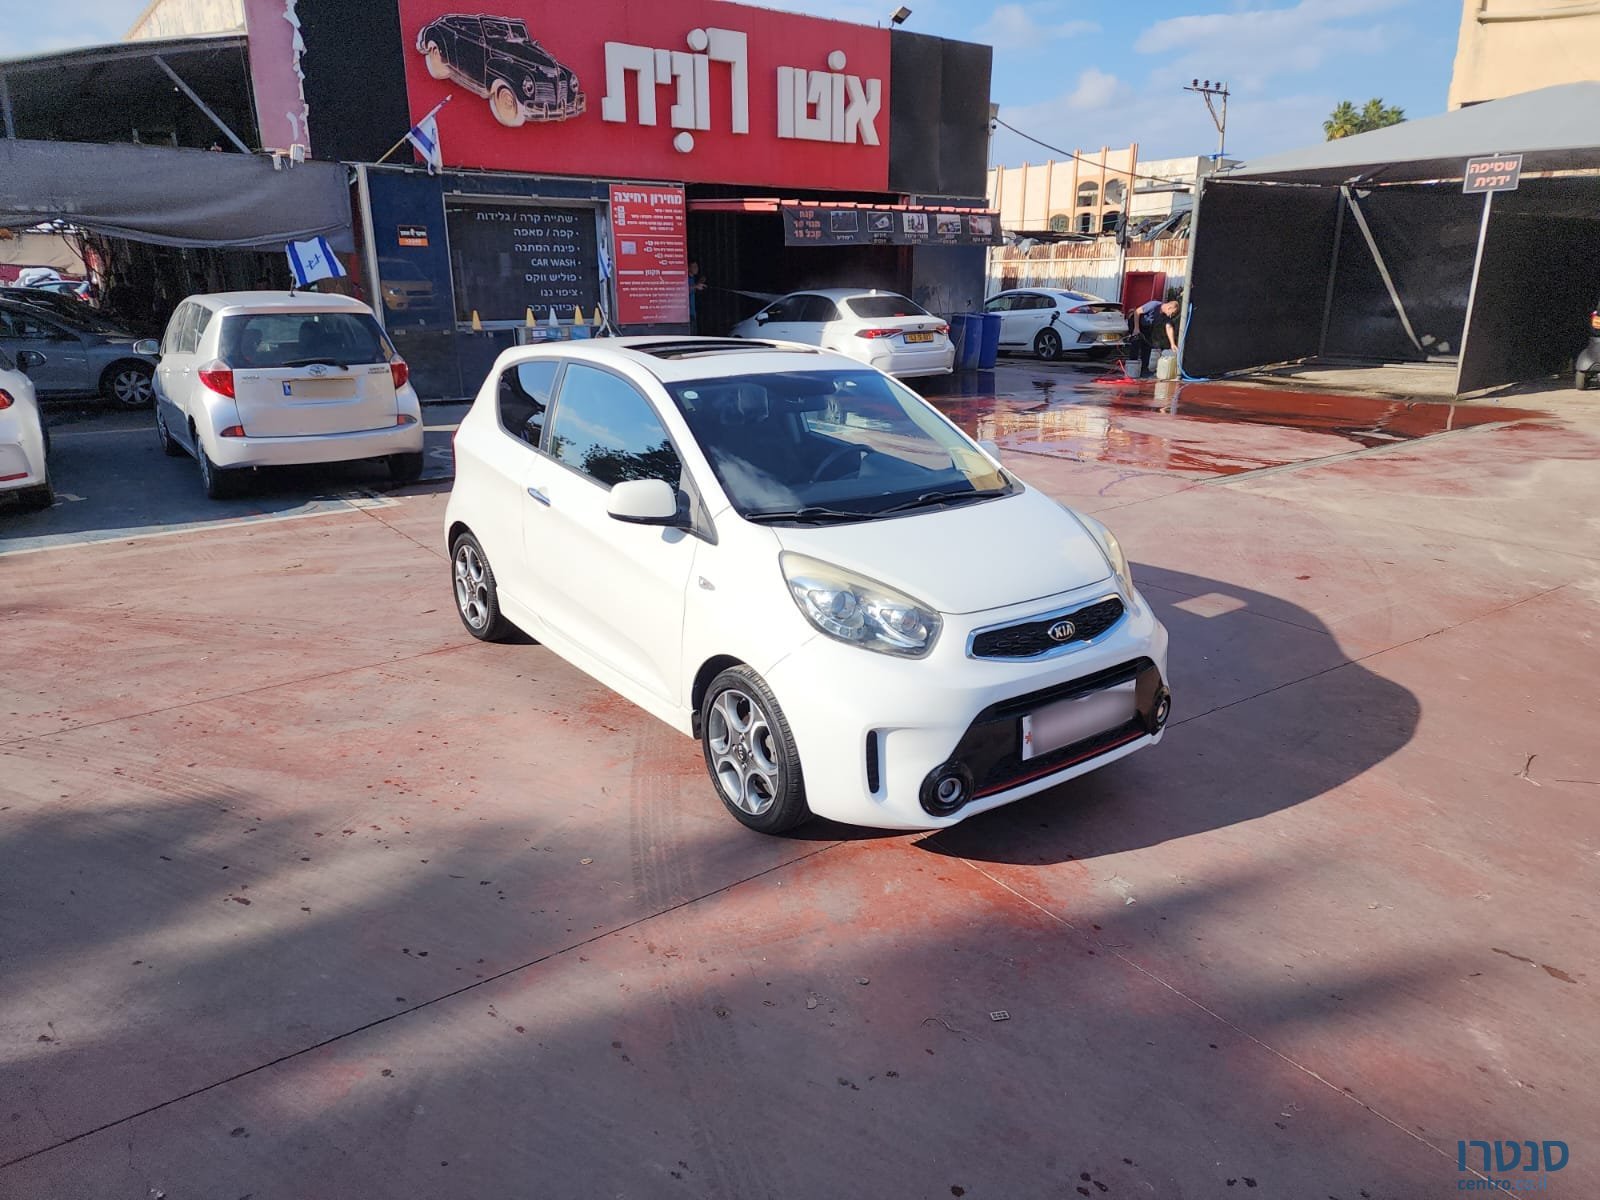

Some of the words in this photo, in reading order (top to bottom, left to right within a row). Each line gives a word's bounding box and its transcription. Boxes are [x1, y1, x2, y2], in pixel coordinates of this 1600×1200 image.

[777, 50, 882, 146] אוטו
[1473, 175, 1511, 187] ידנית
[614, 191, 648, 204] רחיצה
[650, 193, 683, 206] מחירון
[476, 211, 511, 221] גלידות
[519, 213, 541, 224] קרה
[543, 214, 573, 223] שתייה
[513, 227, 544, 236] מאפה
[552, 229, 574, 239] קפה
[552, 244, 575, 253] פינת
[531, 258, 549, 267] CAR
[550, 258, 577, 268] WASH
[525, 273, 547, 284] ווקס
[549, 272, 577, 281] פוליש
[540, 289, 554, 297] ננו
[555, 289, 579, 297] ציפוי
[1054, 625, 1073, 638] KIA
